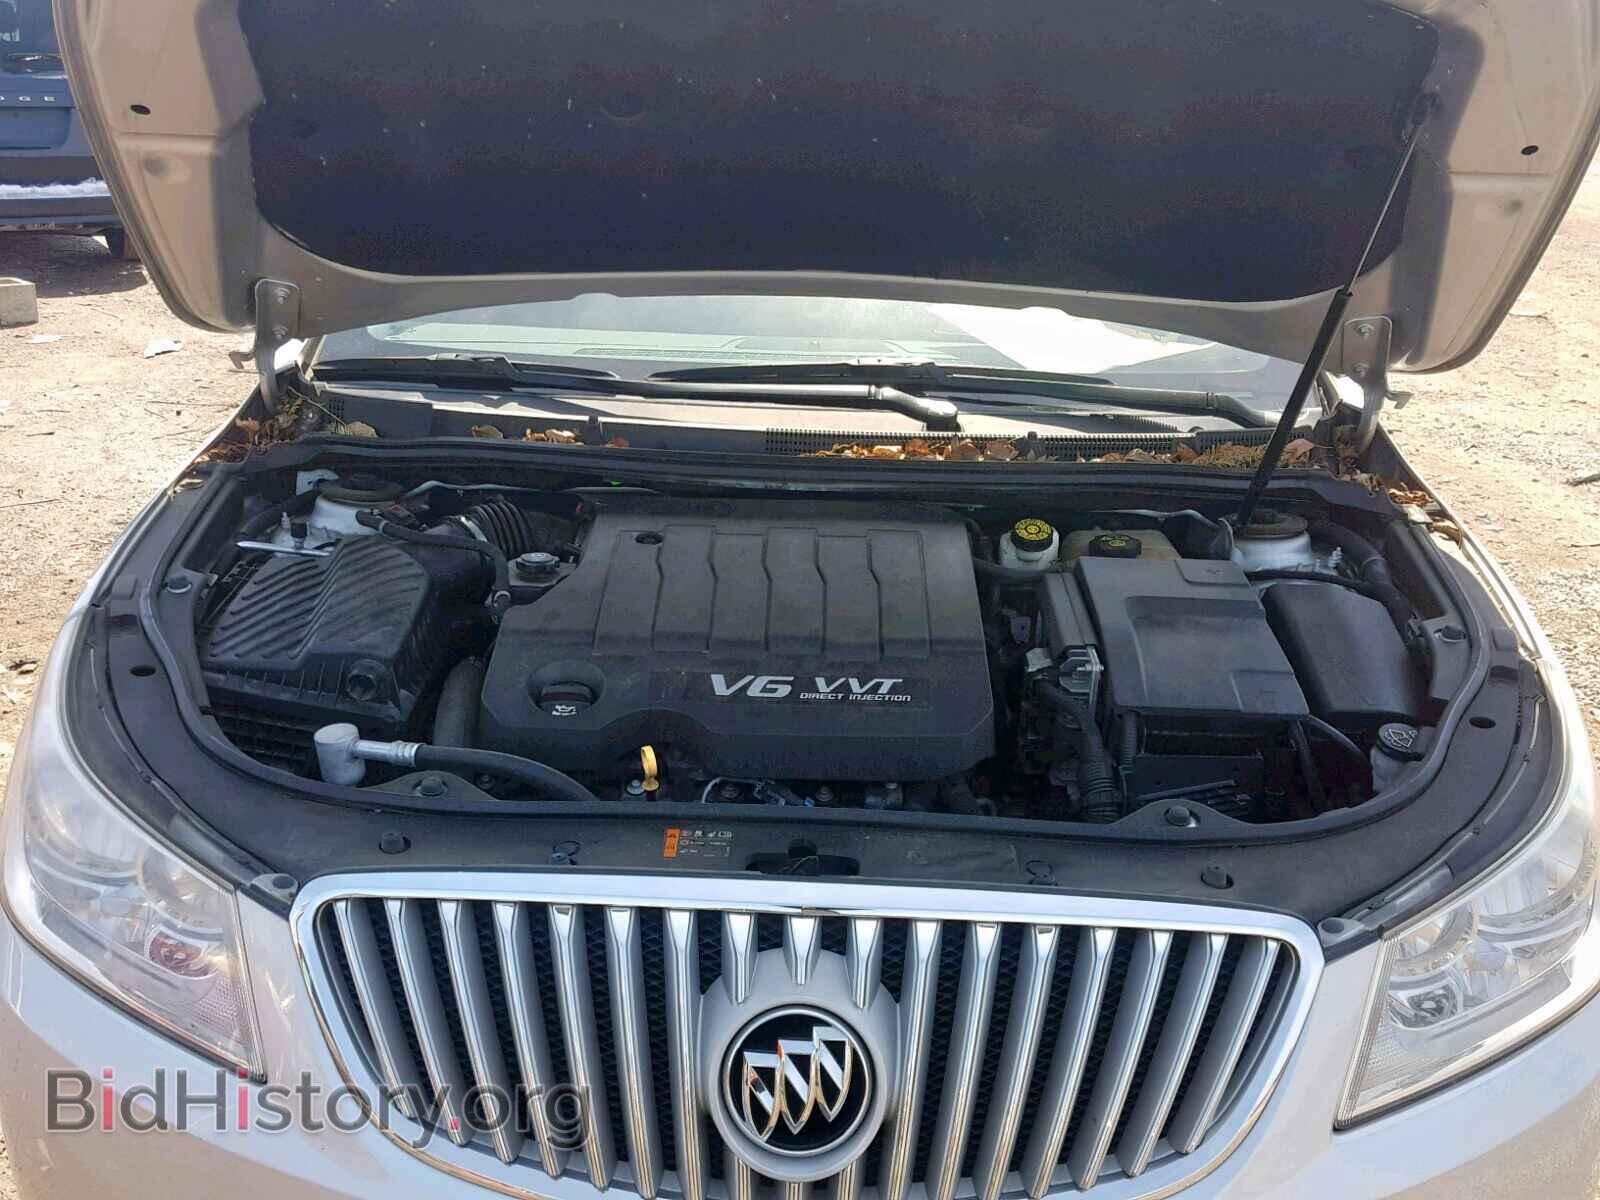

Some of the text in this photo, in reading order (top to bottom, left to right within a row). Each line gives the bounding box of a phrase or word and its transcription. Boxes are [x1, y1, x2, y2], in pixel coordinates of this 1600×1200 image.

[710, 674, 904, 698] V6 VVT
[799, 692, 844, 700] DIRECT
